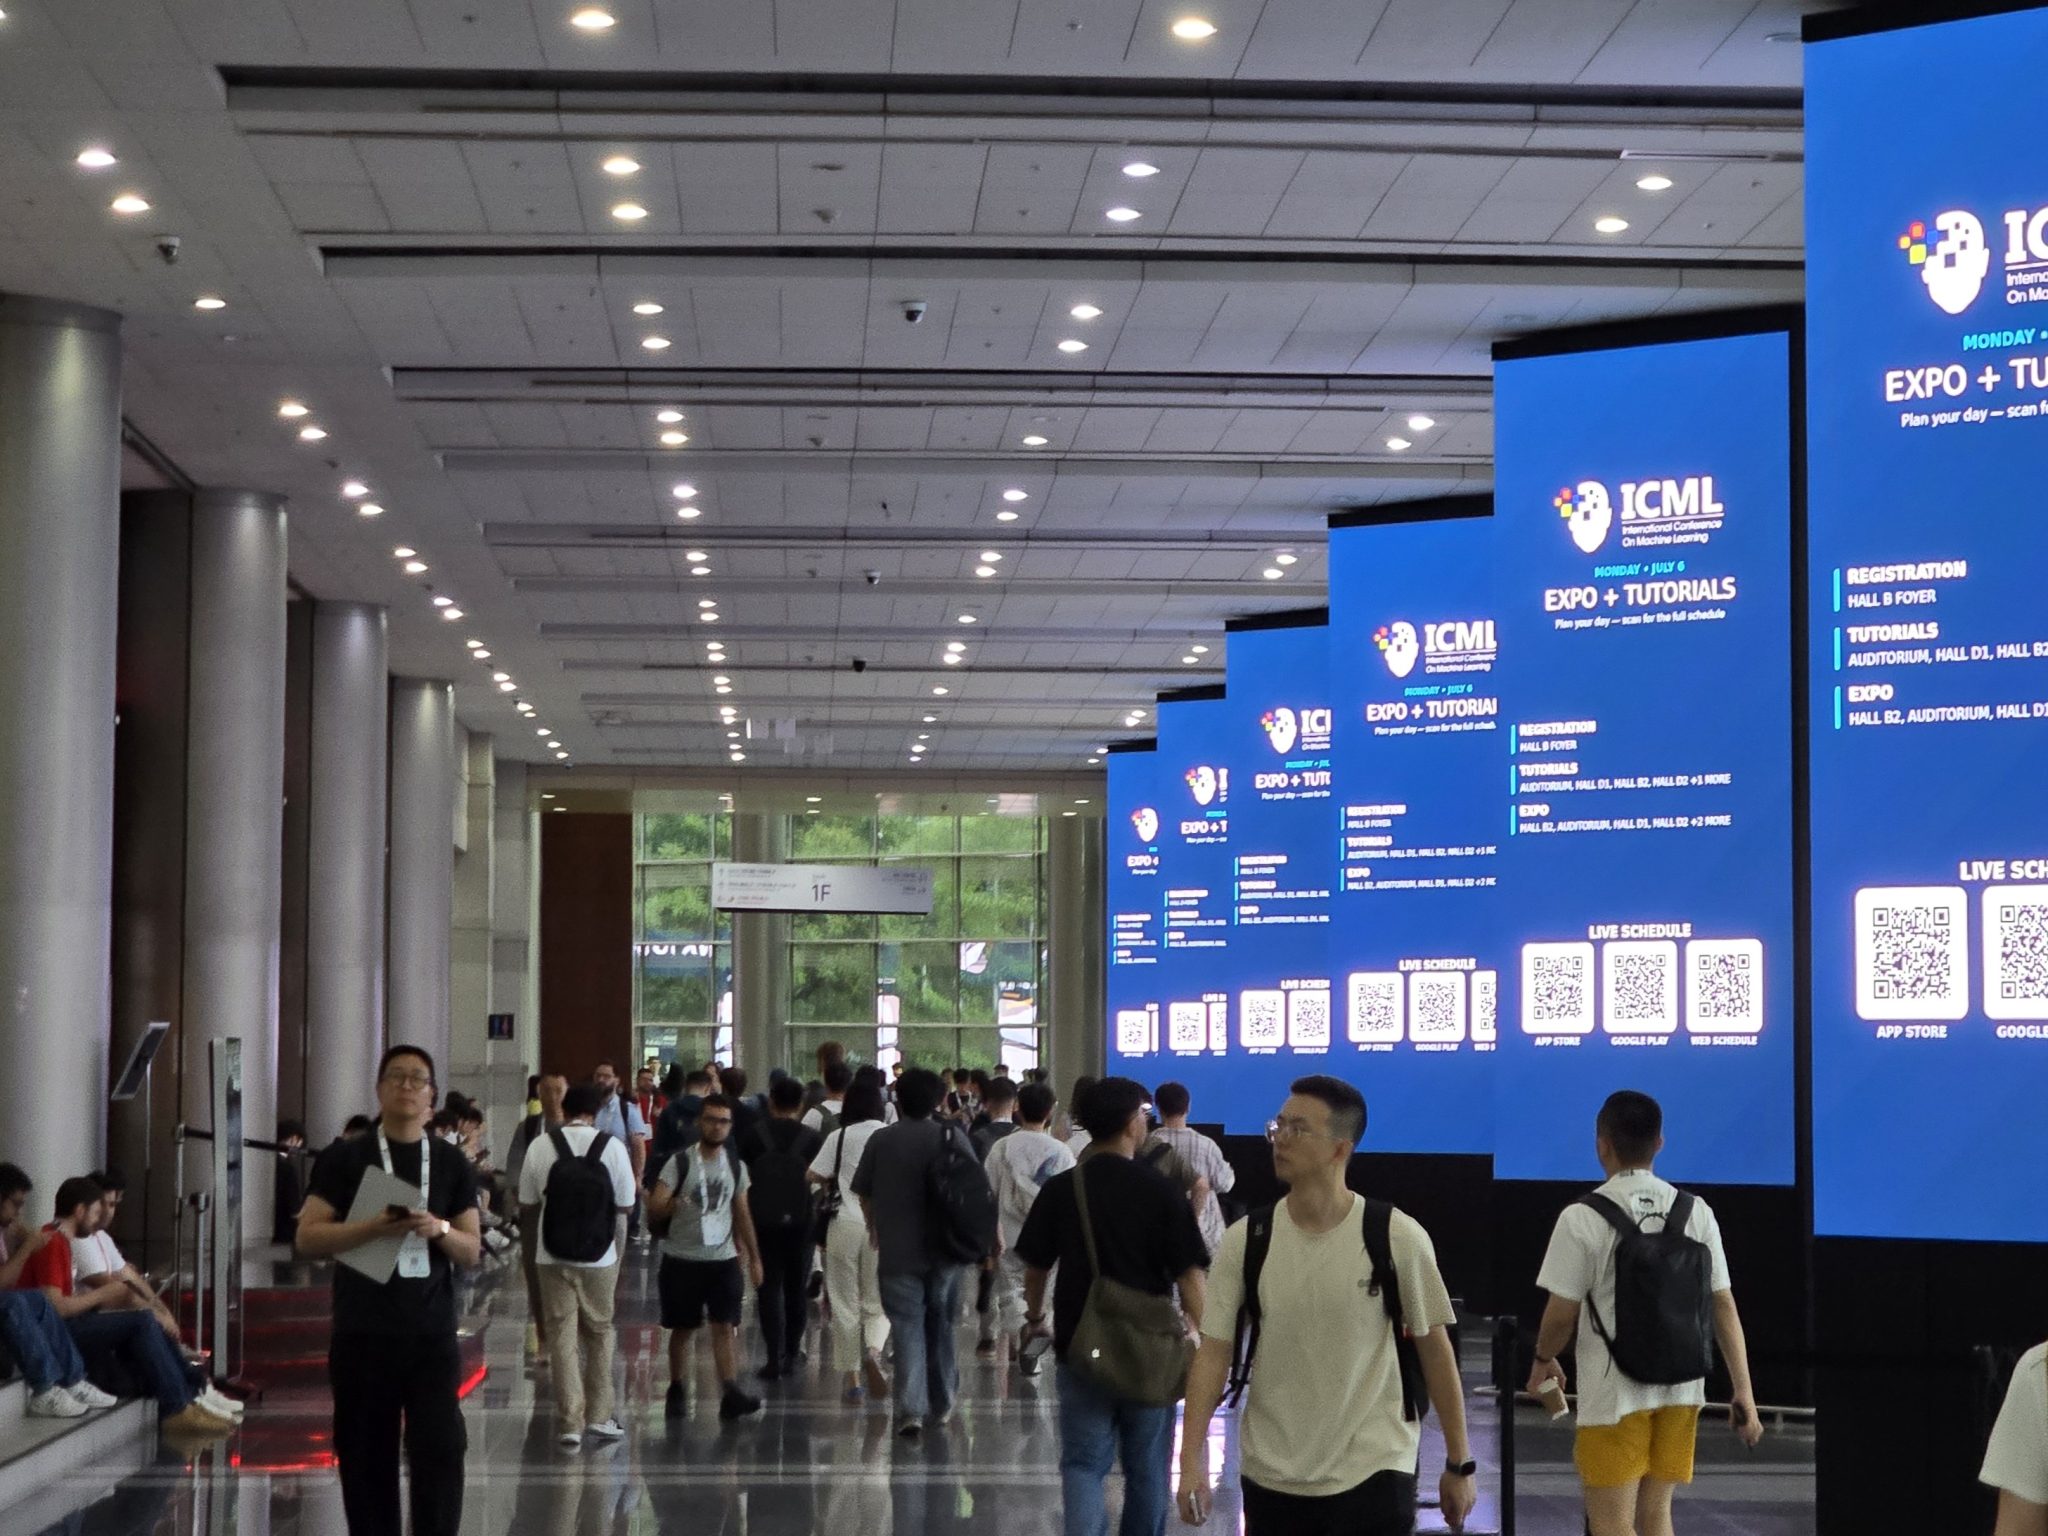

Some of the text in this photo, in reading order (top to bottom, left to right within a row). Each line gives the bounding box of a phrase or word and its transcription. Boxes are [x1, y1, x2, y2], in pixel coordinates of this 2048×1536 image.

[2006, 289, 2027, 304] On
[1963, 328, 2036, 350] MONDAY
[1886, 364, 1967, 402] EXPO
[1977, 366, 2000, 392] +
[1901, 411, 1929, 428] Plan
[1931, 409, 1961, 428] your
[1963, 406, 1988, 424] day
[2007, 404, 2037, 418] scan
[1620, 476, 1723, 520] ICML
[1622, 522, 1672, 535] International
[1622, 532, 1709, 547] On Machine Learning
[1594, 563, 1641, 578] MONDAY
[1651, 561, 1675, 576] JULY
[1677, 560, 1686, 572] 6
[1847, 560, 1967, 584] REGISTRATION
[1545, 577, 1736, 611] EXPO + TUTORIALS
[1848, 589, 1937, 608] HALL B FOYER
[1847, 622, 1939, 643] TUTORIALS
[1848, 649, 1933, 667] AUDITORIUM,
[1935, 646, 1969, 662] HALL
[1971, 645, 1994, 661] D1,
[1996, 643, 2031, 658] HALL
[1848, 684, 1894, 702] EXPO
[1366, 702, 1408, 721] EXPO
[1849, 711, 1881, 726] HALL
[1884, 710, 1905, 725] B2,
[1907, 705, 1994, 722] AUDITORIUM,
[1996, 703, 2031, 719] HALL
[1519, 720, 1597, 737] REGISTRATION
[1520, 741, 1541, 753] HALL
[1550, 739, 1578, 751] FOYER
[1519, 762, 1579, 777] TUTORIALS
[1255, 772, 1288, 789] EXPO
[1575, 779, 1597, 791] HALL
[1959, 861, 2006, 880] LIVE
[811, 884, 831, 901] 1F
[1588, 923, 1692, 940] LIVE SCHEDULE
[1876, 1025, 1948, 1038] APP STORE
